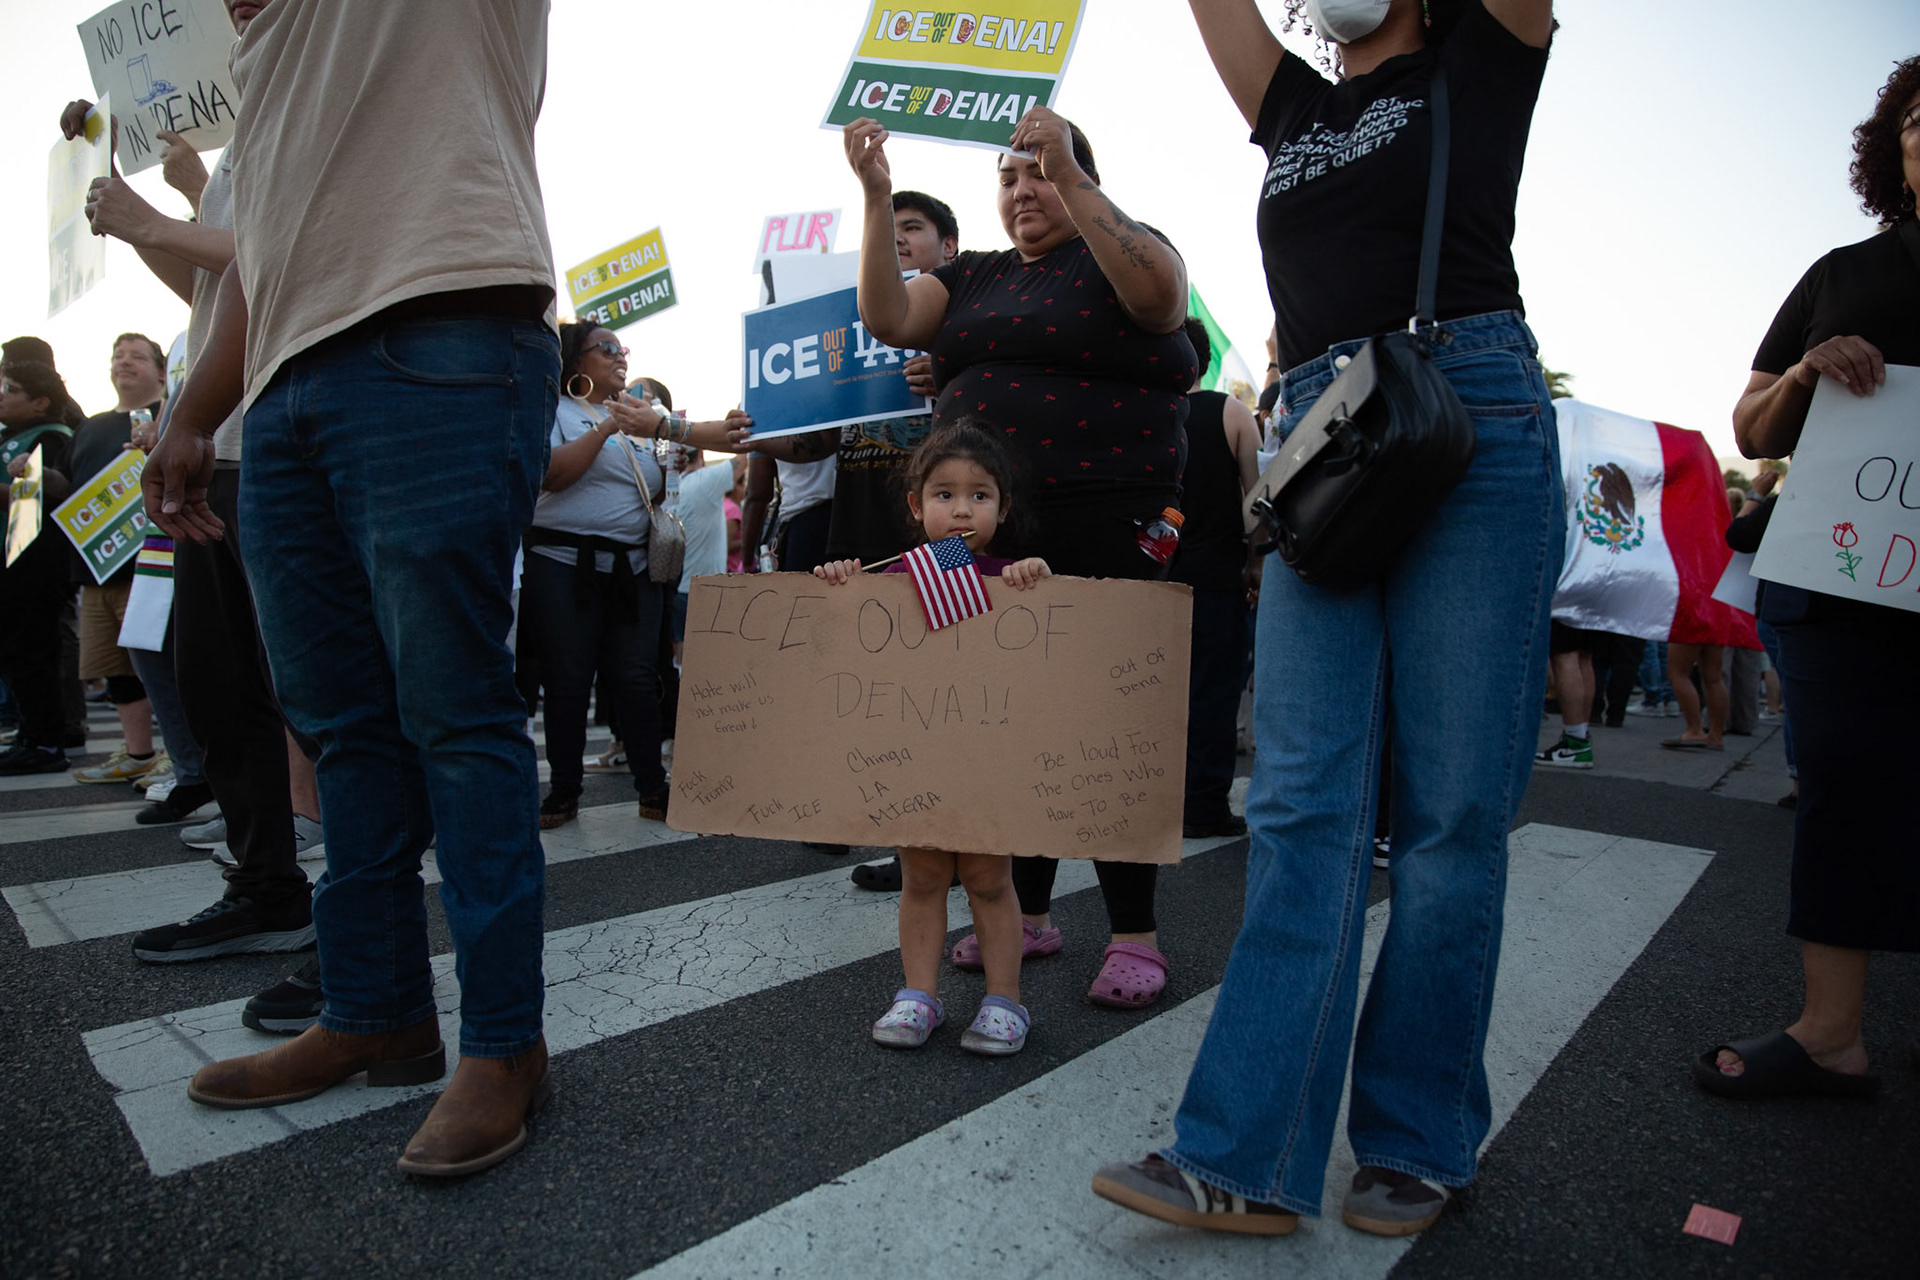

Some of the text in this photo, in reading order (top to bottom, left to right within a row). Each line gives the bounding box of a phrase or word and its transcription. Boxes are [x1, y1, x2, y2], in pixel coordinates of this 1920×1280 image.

[97, 18, 124, 64] NO
[131, 0, 183, 45] ICE
[874, 9, 1064, 55] ICE OUT OF DENA!
[847, 79, 911, 112] ICE
[906, 100, 923, 115] OF
[910, 85, 933, 101] OUT
[125, 114, 151, 162] IN
[1264, 172, 1302, 199] JUST
[1305, 161, 1328, 182] BE
[1332, 132, 1396, 168] QUIET?
[762, 212, 834, 254] PLUR
[572, 268, 600, 295] ICE
[608, 242, 659, 278] DENA!
[618, 279, 670, 315] DENA!
[823, 327, 847, 351] OUT
[749, 334, 820, 389] ICE
[828, 350, 844, 373] OF
[69, 497, 106, 533] ICE
[107, 455, 149, 500] DEN
[93, 530, 127, 565] ICE
[691, 583, 827, 651] ICE
[994, 603, 1074, 659] OF
[690, 679, 723, 701] Hate
[719, 700, 750, 715] make
[816, 672, 1010, 730] DENA!!
[847, 747, 913, 773] Chinga
[1034, 751, 1067, 772] Be
[1125, 732, 1161, 756] For
[858, 781, 890, 803] LA
[1031, 760, 1165, 798] The Ones Who
[788, 798, 822, 823] ICE
[868, 791, 942, 827] MIGRA
[1045, 806, 1075, 822] Have
[1119, 791, 1147, 807] Be
[1076, 815, 1130, 843] Silent
